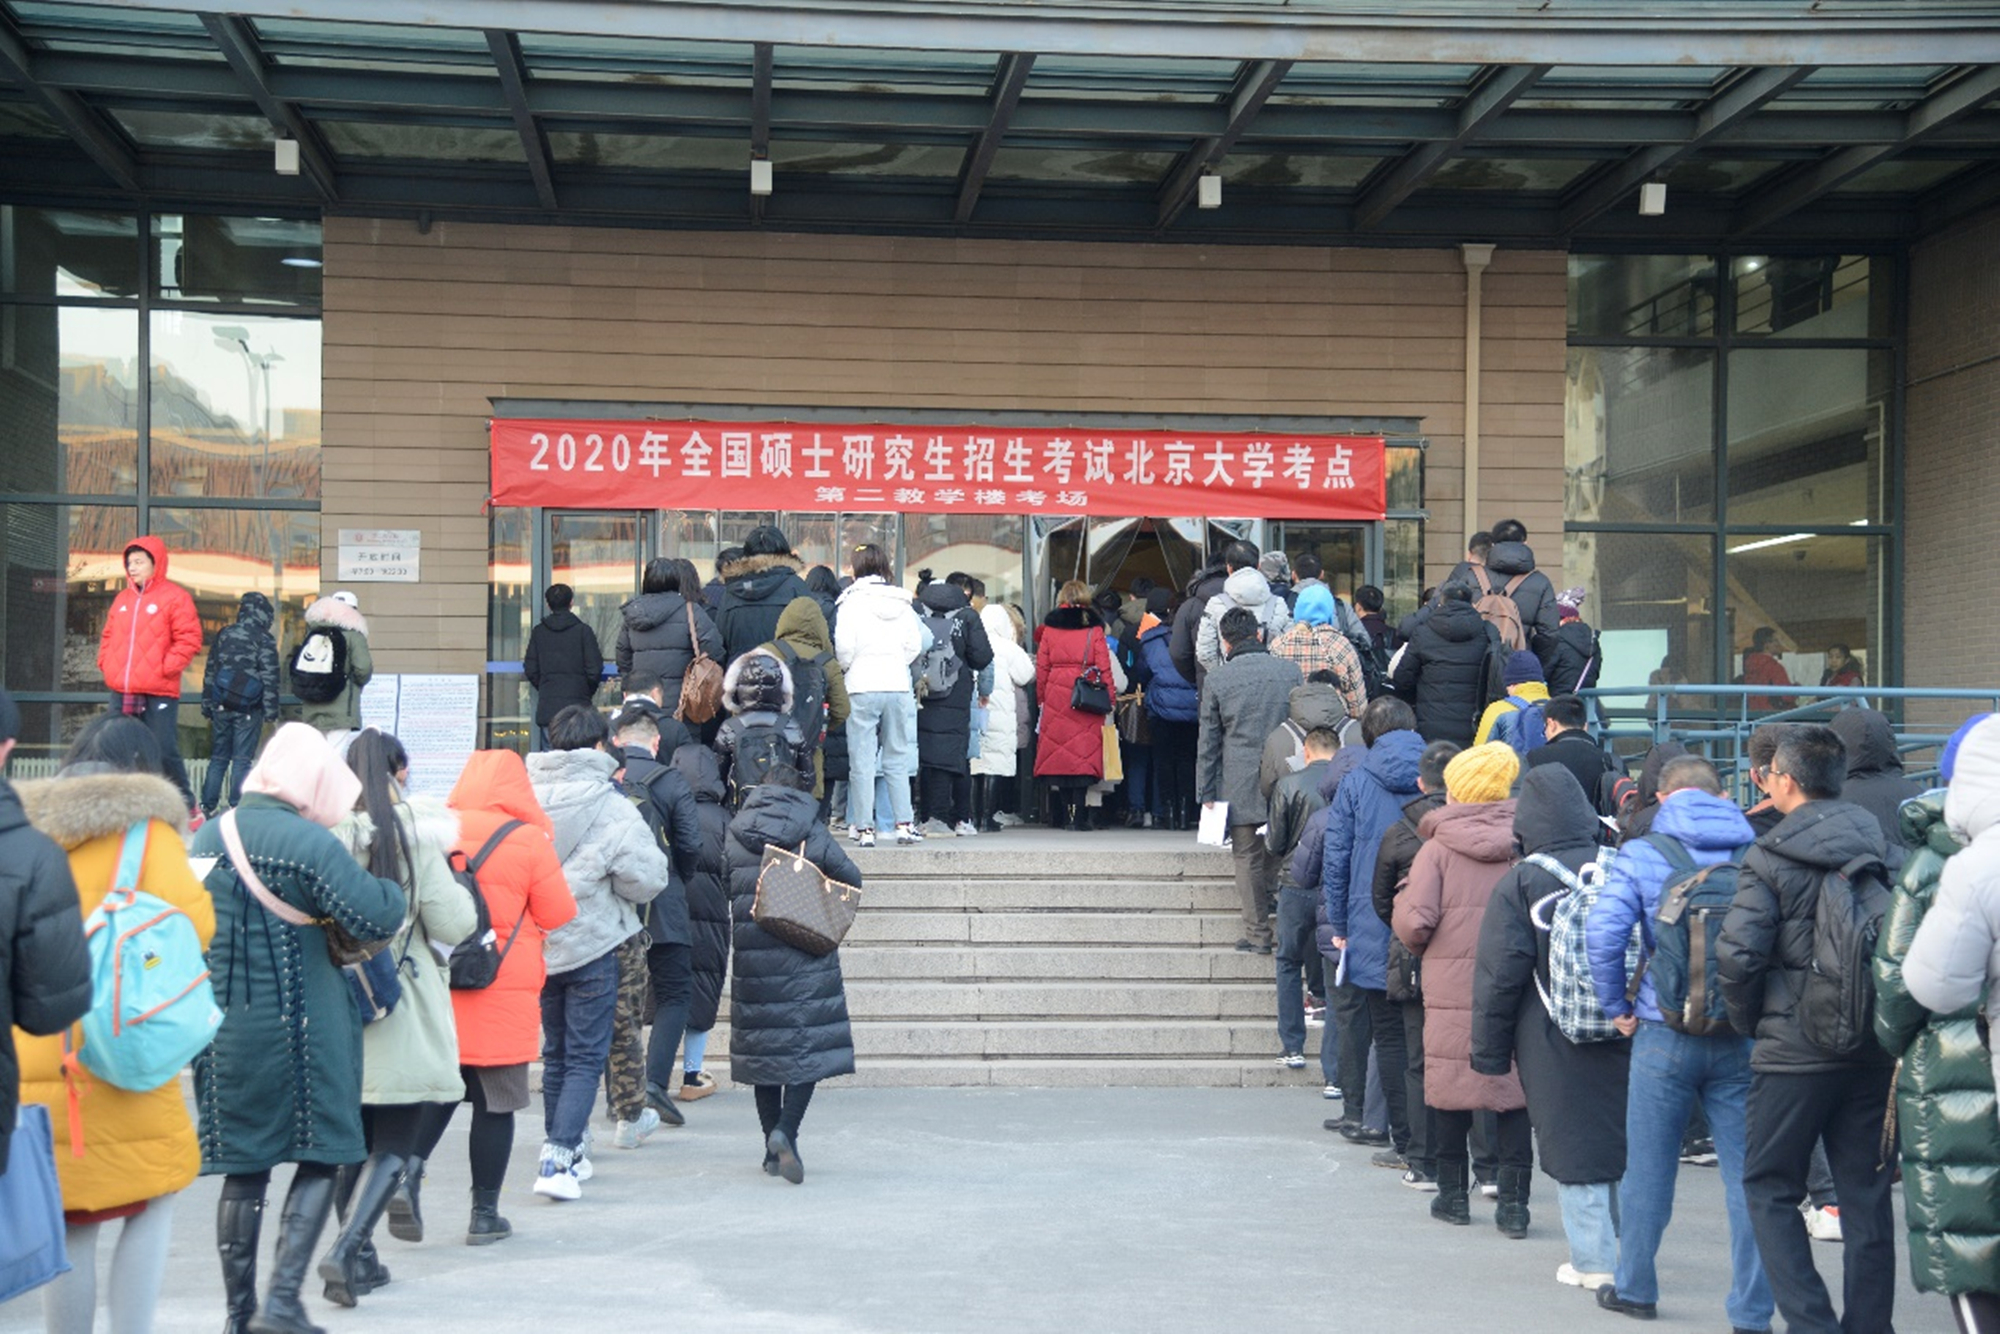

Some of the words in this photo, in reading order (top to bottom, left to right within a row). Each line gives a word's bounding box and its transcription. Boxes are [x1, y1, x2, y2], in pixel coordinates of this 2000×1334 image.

[530, 430, 1355, 490] 2020年全国硕士研究生招生考试北京大学考点
[814, 486, 1088, 507] 第二教学楼考场
